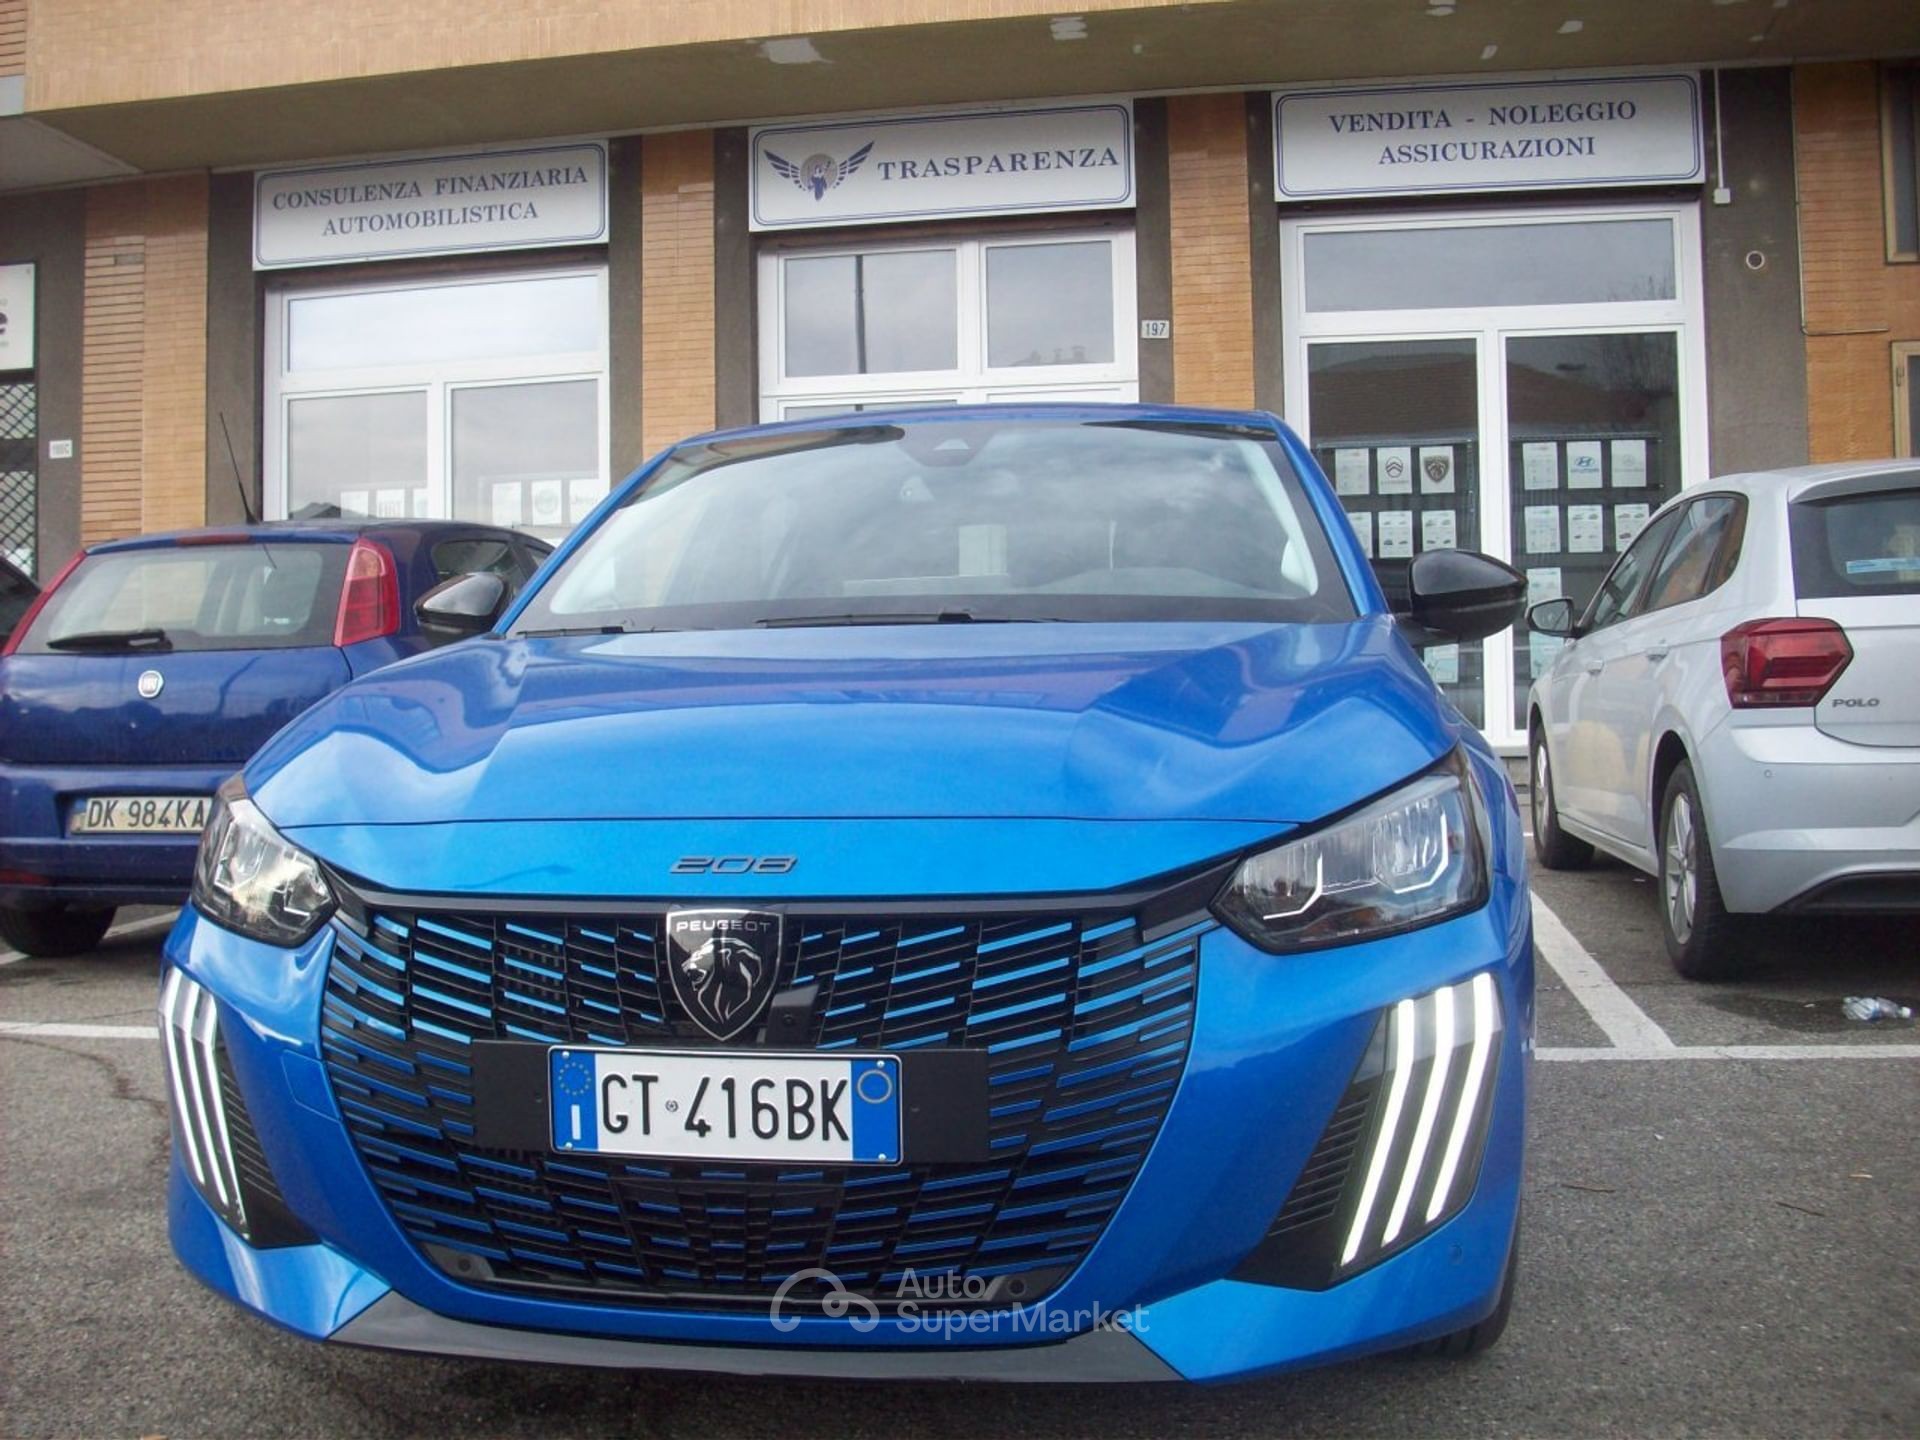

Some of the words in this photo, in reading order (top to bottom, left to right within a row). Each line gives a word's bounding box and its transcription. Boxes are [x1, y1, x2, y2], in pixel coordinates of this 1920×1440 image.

[1328, 108, 1451, 133] VENDITA
[1488, 100, 1637, 126] NOLEGGIO
[877, 146, 1120, 180] TRASPARENZA
[1378, 136, 1597, 165] ASSICURAZIONI
[272, 180, 423, 211] CONSULENZA
[434, 165, 589, 196] FINANZIARIA
[322, 202, 539, 237] AUTOMOBILISTICA
[1144, 321, 1168, 338] 197
[1832, 698, 1880, 708] POLO
[87, 799, 119, 828] DK
[128, 799, 205, 828] 984KA
[669, 854, 798, 875] 208
[676, 918, 772, 933] PEUGEOT
[601, 1073, 659, 1136] GT
[684, 1076, 850, 1142] 416BK
